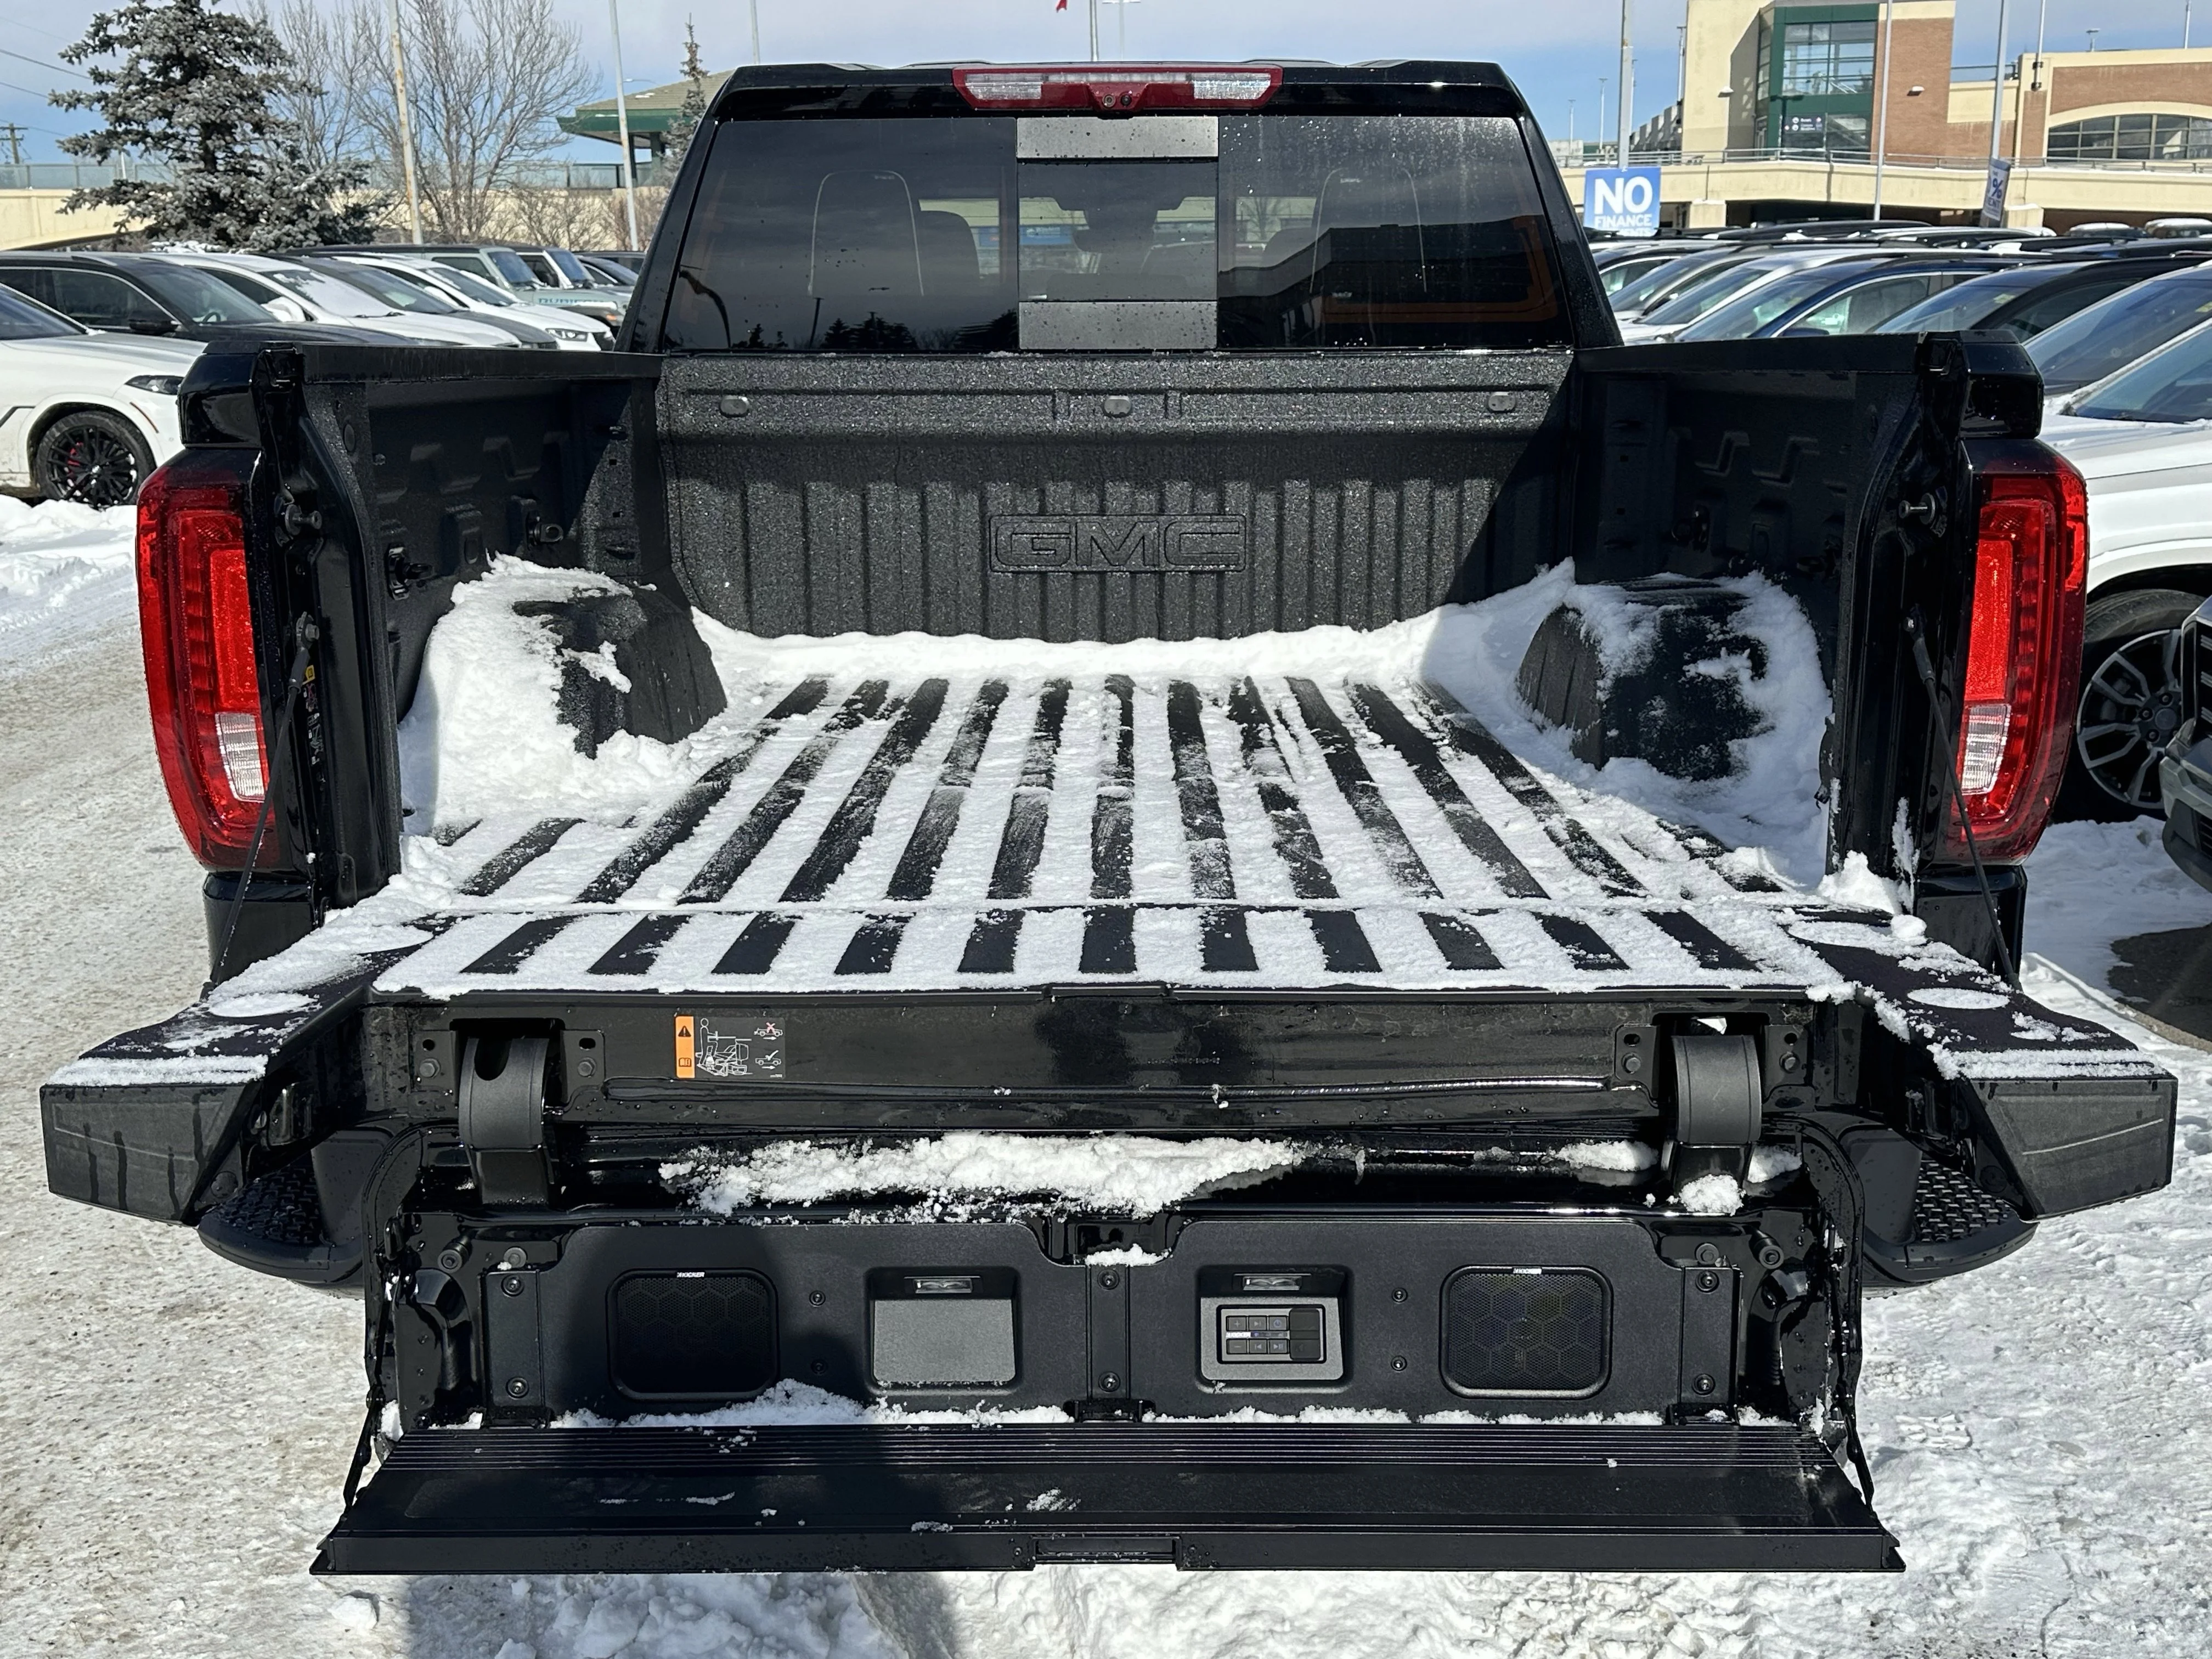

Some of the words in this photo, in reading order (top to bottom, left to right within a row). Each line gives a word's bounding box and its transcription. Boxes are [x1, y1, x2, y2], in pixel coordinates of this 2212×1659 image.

[1594, 176, 1652, 215] NO
[1594, 213, 1652, 229] FINANCE
[996, 521, 1240, 567] GMC
